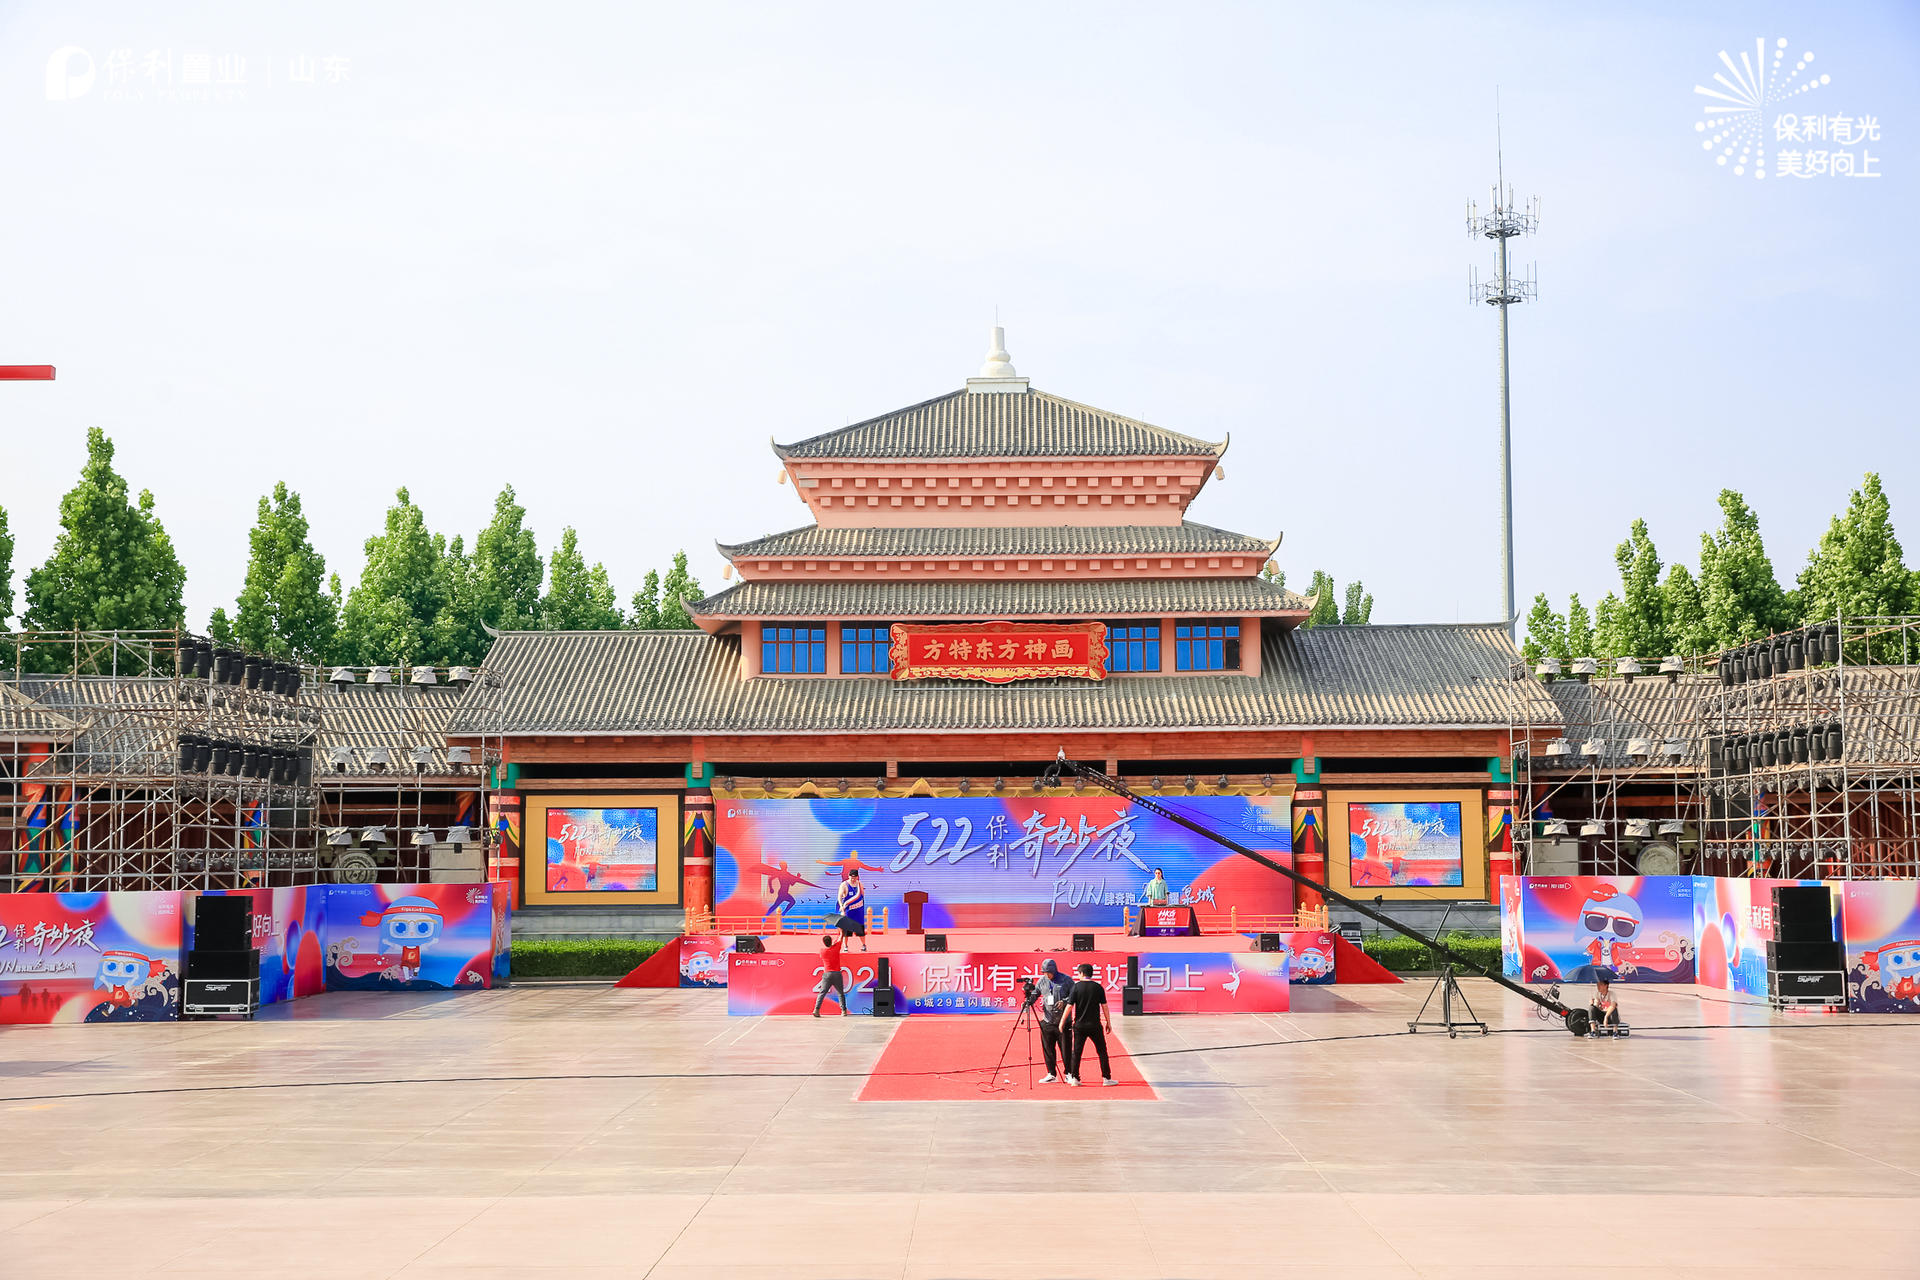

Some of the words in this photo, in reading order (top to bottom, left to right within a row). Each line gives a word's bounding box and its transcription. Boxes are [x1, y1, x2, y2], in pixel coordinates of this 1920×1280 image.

[922, 637, 1075, 662] 方特东方神画
[888, 811, 987, 873] 522
[986, 814, 1009, 870] 保利
[1010, 807, 1152, 878] 奇妙夜
[1051, 877, 1106, 919] FUN
[26, 918, 102, 956] 奇妙夜
[1797, 975, 1824, 983] SUPER
